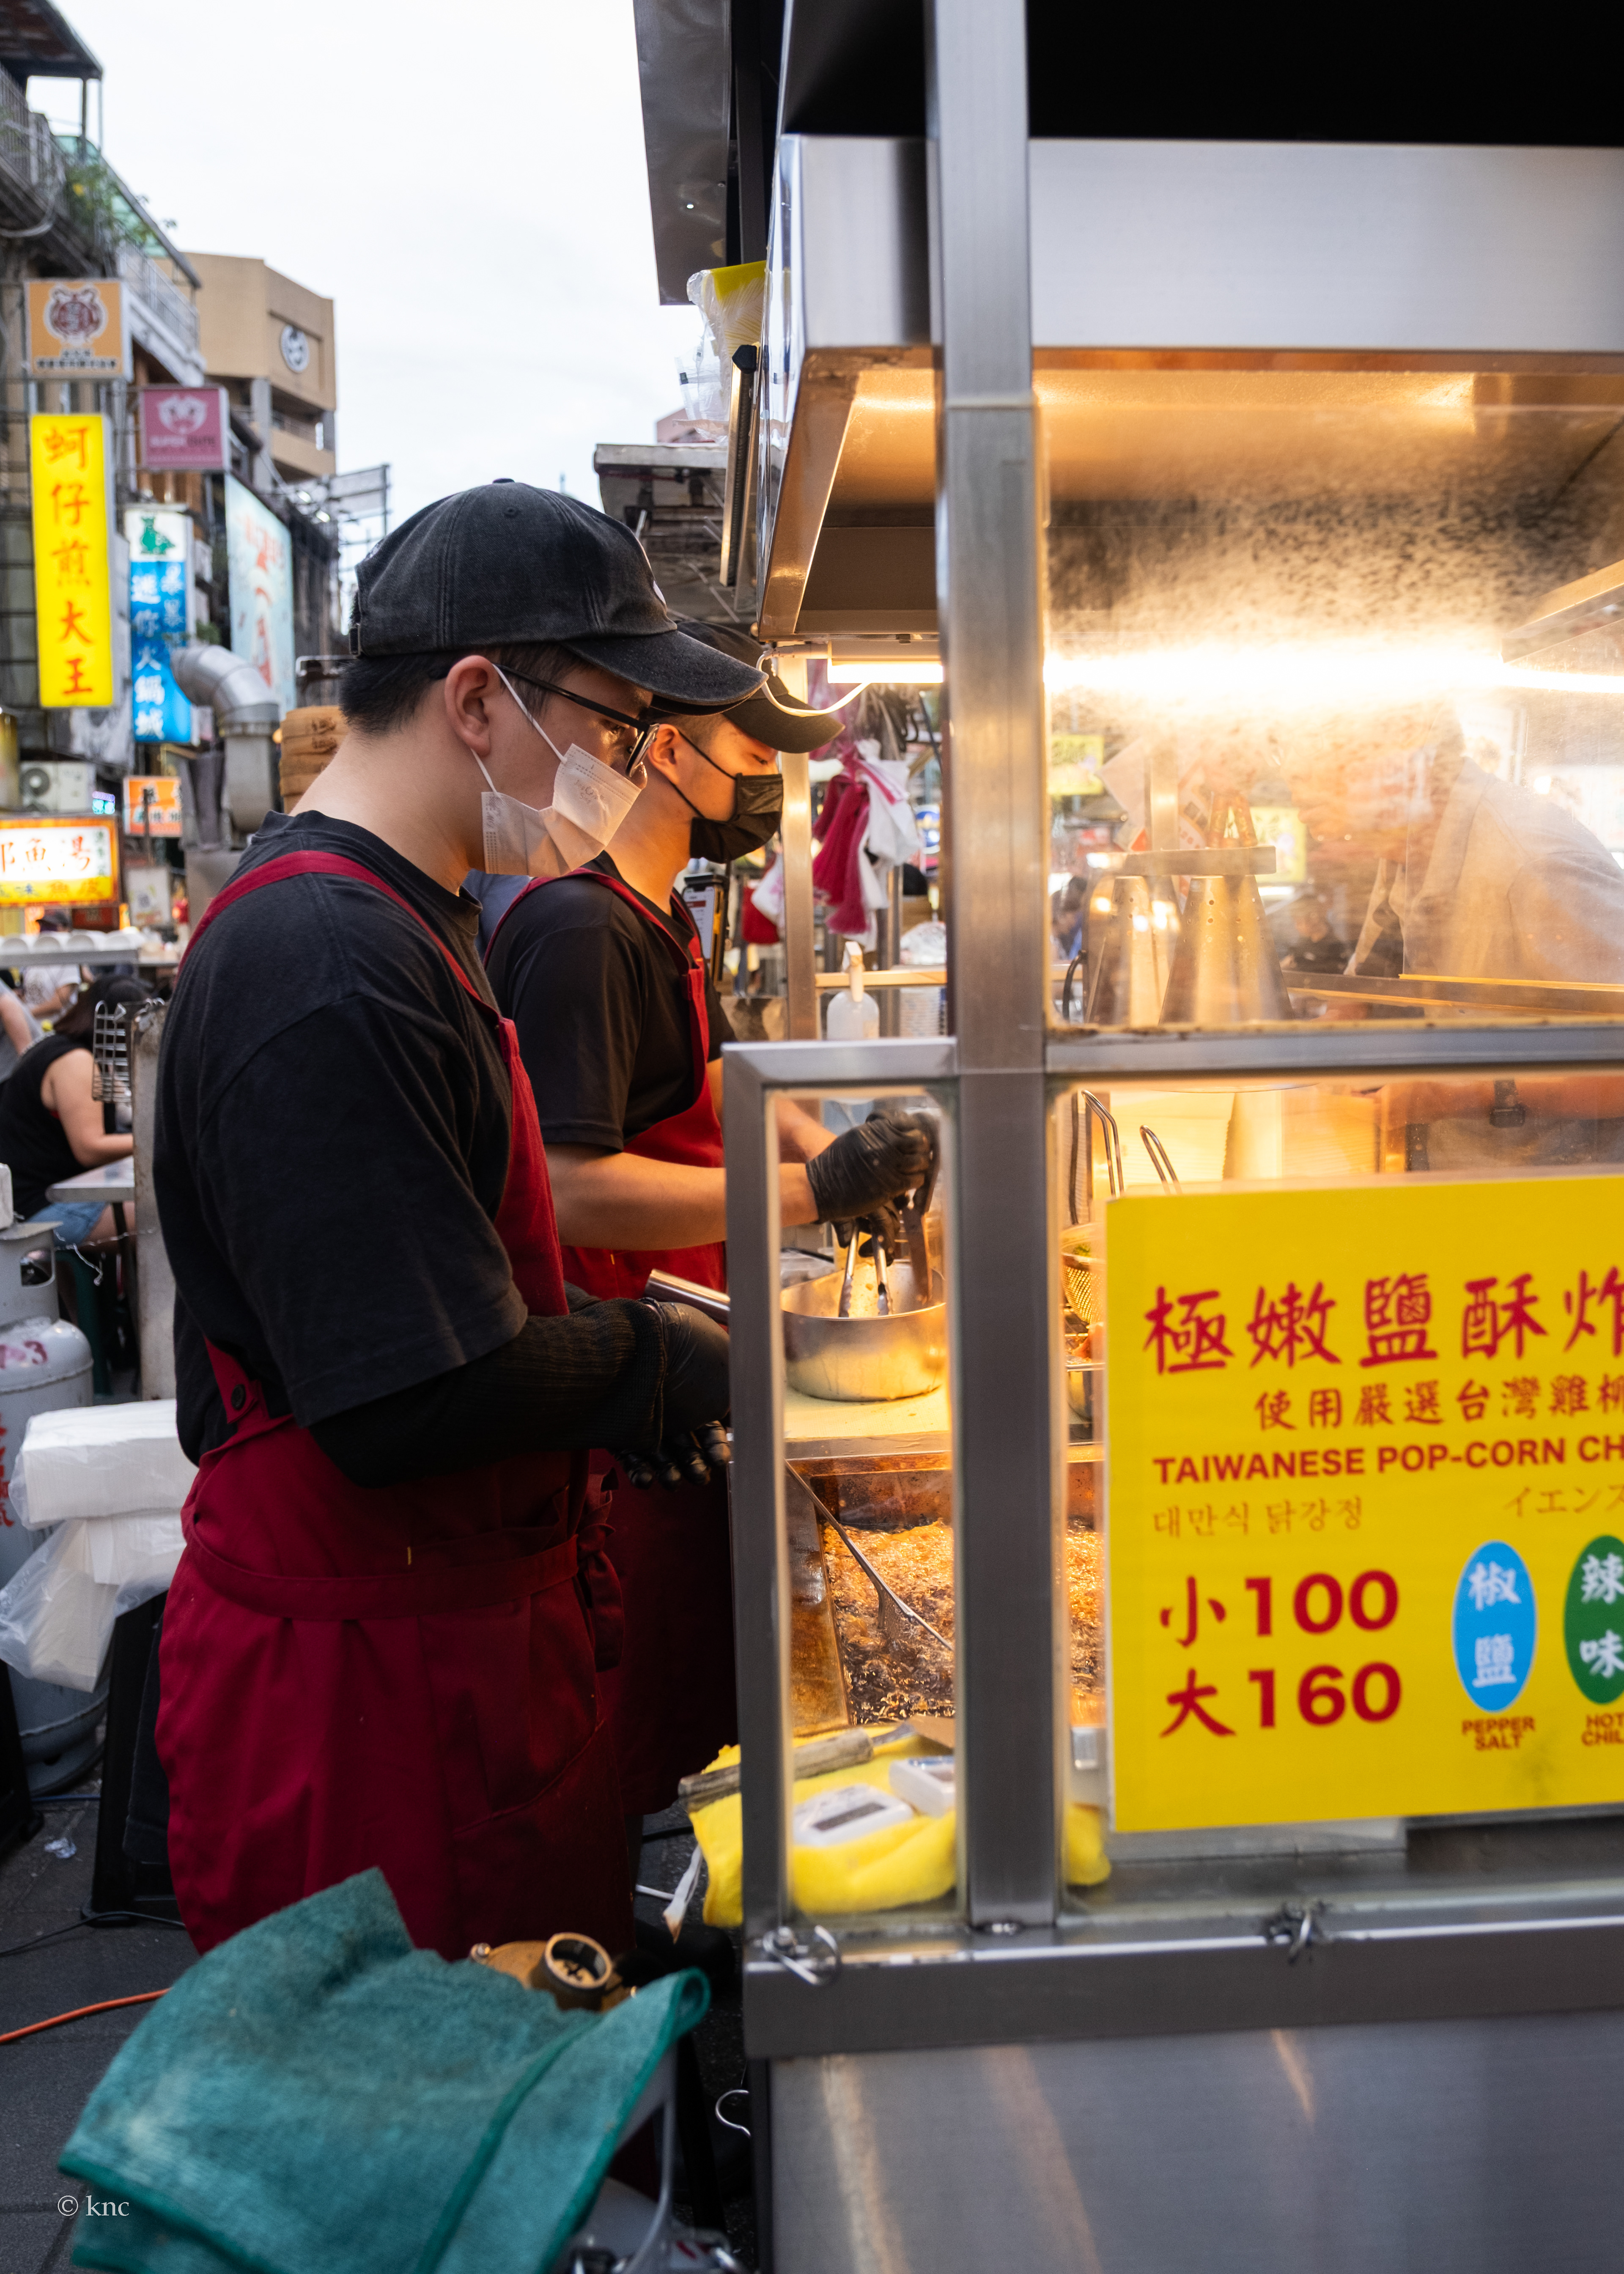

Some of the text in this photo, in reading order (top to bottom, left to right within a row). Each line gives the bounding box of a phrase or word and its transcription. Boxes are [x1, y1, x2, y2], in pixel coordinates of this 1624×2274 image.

[44, 426, 94, 695] 蚵仔煎大王
[132, 574, 165, 740] 迷你火鍋城
[1143, 1266, 1624, 1375] 極嫩鹽酥炸
[1153, 1434, 1624, 1485] TAIWANESE POP-CORN CH
[1153, 1496, 1362, 1538] 대만식 닭강정
[1468, 1560, 1522, 1688] 椒鹽
[1579, 1552, 1624, 1679] 辣味
[1461, 1716, 1536, 1735] PEPPER
[1474, 1733, 1522, 1751] SALT
[1586, 1712, 1624, 1730] HOT
